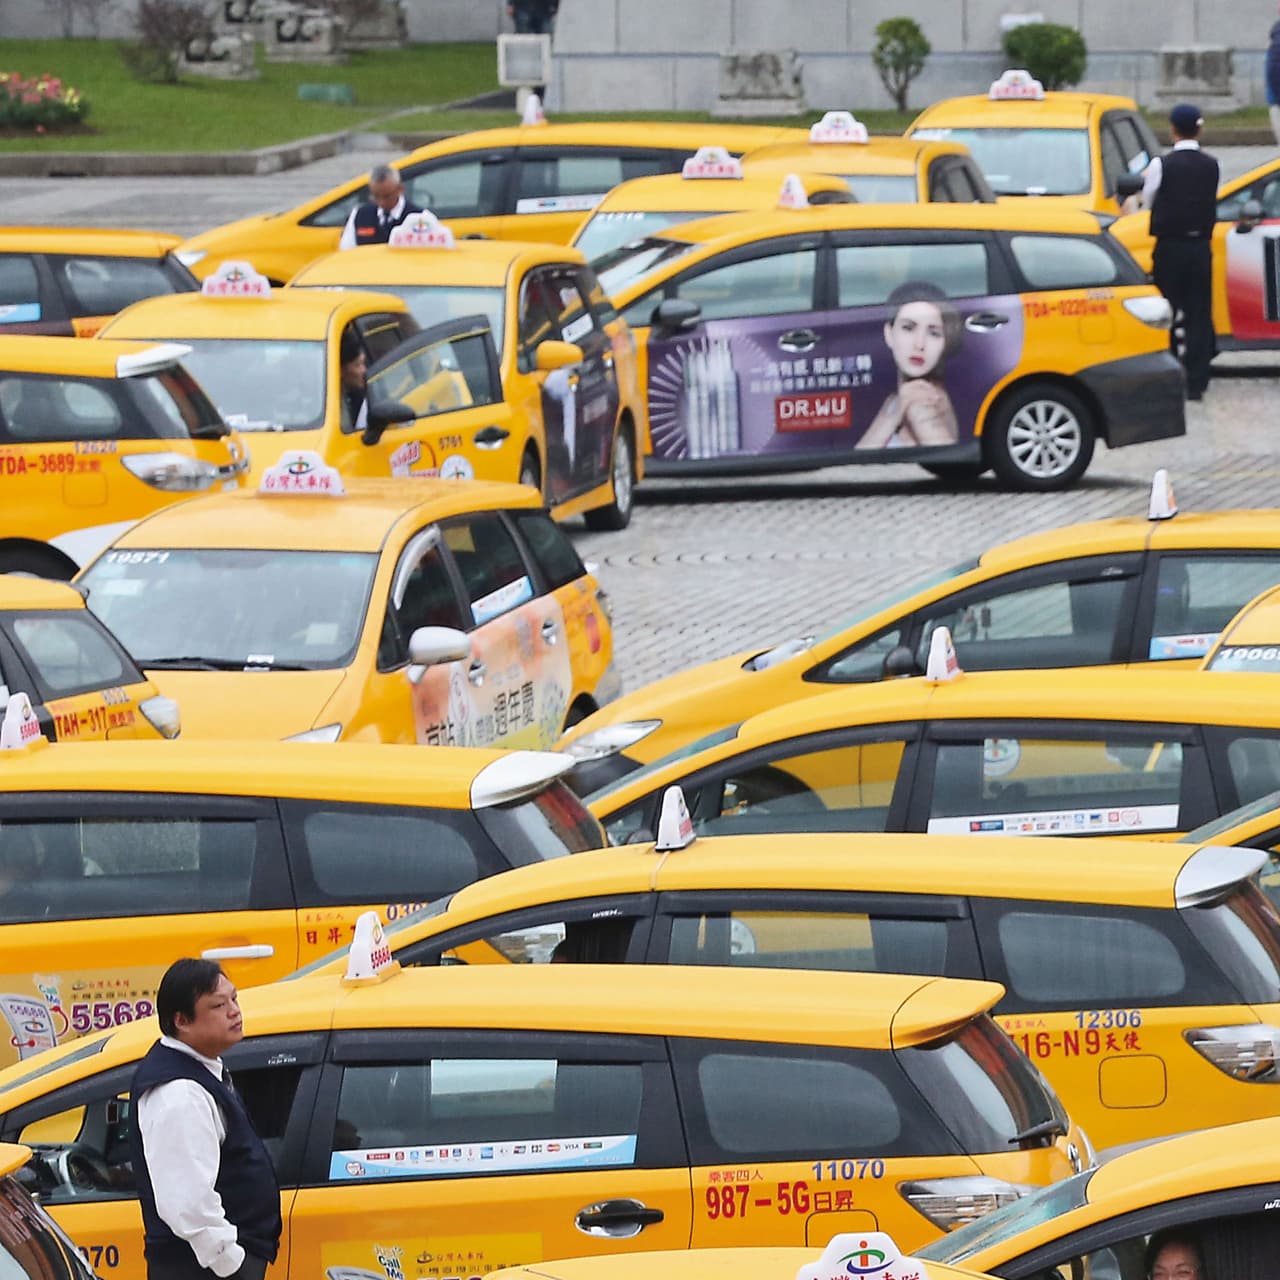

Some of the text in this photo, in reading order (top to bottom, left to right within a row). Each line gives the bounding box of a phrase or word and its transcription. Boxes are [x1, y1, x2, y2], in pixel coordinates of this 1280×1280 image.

[779, 397, 848, 420] DR.WU
[72, 1001, 155, 1032] 5568
[1075, 1009, 1142, 1029] 12306
[1105, 1031, 1142, 1052] 天使
[708, 1169, 764, 1183] 乘客四人
[811, 1159, 885, 1181] 11070
[705, 1181, 855, 1220] 987-5G 日昇
[378, 1255, 401, 1270] Call
